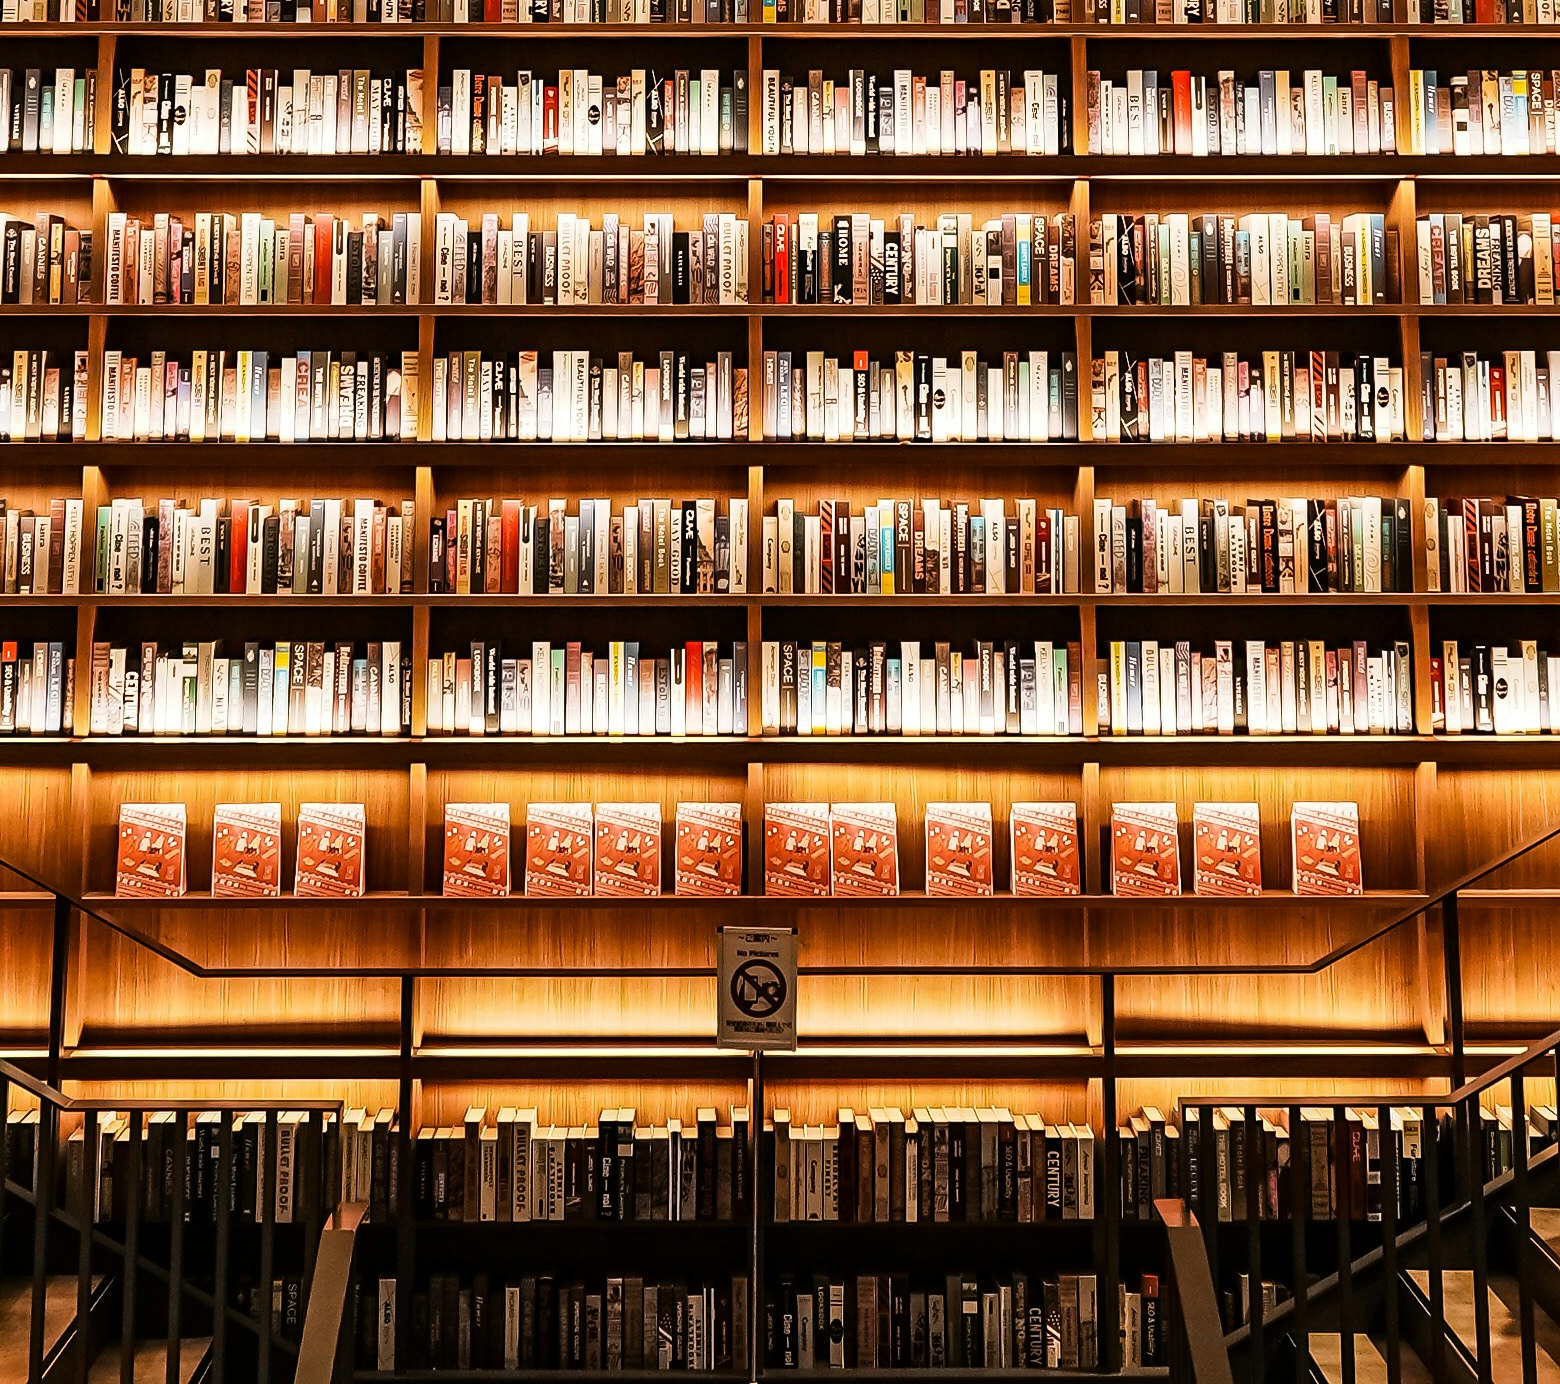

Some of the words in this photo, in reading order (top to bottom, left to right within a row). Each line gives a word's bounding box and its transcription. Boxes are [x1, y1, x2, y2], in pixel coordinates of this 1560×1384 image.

[1532, 73, 1541, 109] SPACE
[839, 229, 848, 266] HOME
[1035, 217, 1045, 255] SPACE
[886, 242, 898, 294] CENTURY
[1050, 245, 1058, 292] DREAMS
[1477, 228, 1491, 289] DREAMS
[1492, 238, 1501, 291] FREAKING
[658, 507, 666, 522] The
[899, 503, 908, 541] SPACE
[201, 527, 210, 566] BEST
[915, 531, 923, 579] DREAMS
[1186, 526, 1195, 566] BEST
[294, 644, 303, 683] SPACE
[784, 644, 792, 683] SPACE
[280, 1130, 290, 1168] BULLET
[517, 1129, 525, 1163] BULLET
[280, 1170, 288, 1213] PROOF
[517, 1169, 526, 1212] PROOF
[808, 1160, 817, 1194] Company
[1048, 1151, 1059, 1207] CENTURY
[1139, 1146, 1148, 1204] FREAKING
[287, 1283, 296, 1324] SPACE
[1030, 1308, 1041, 1365] CENTURY
